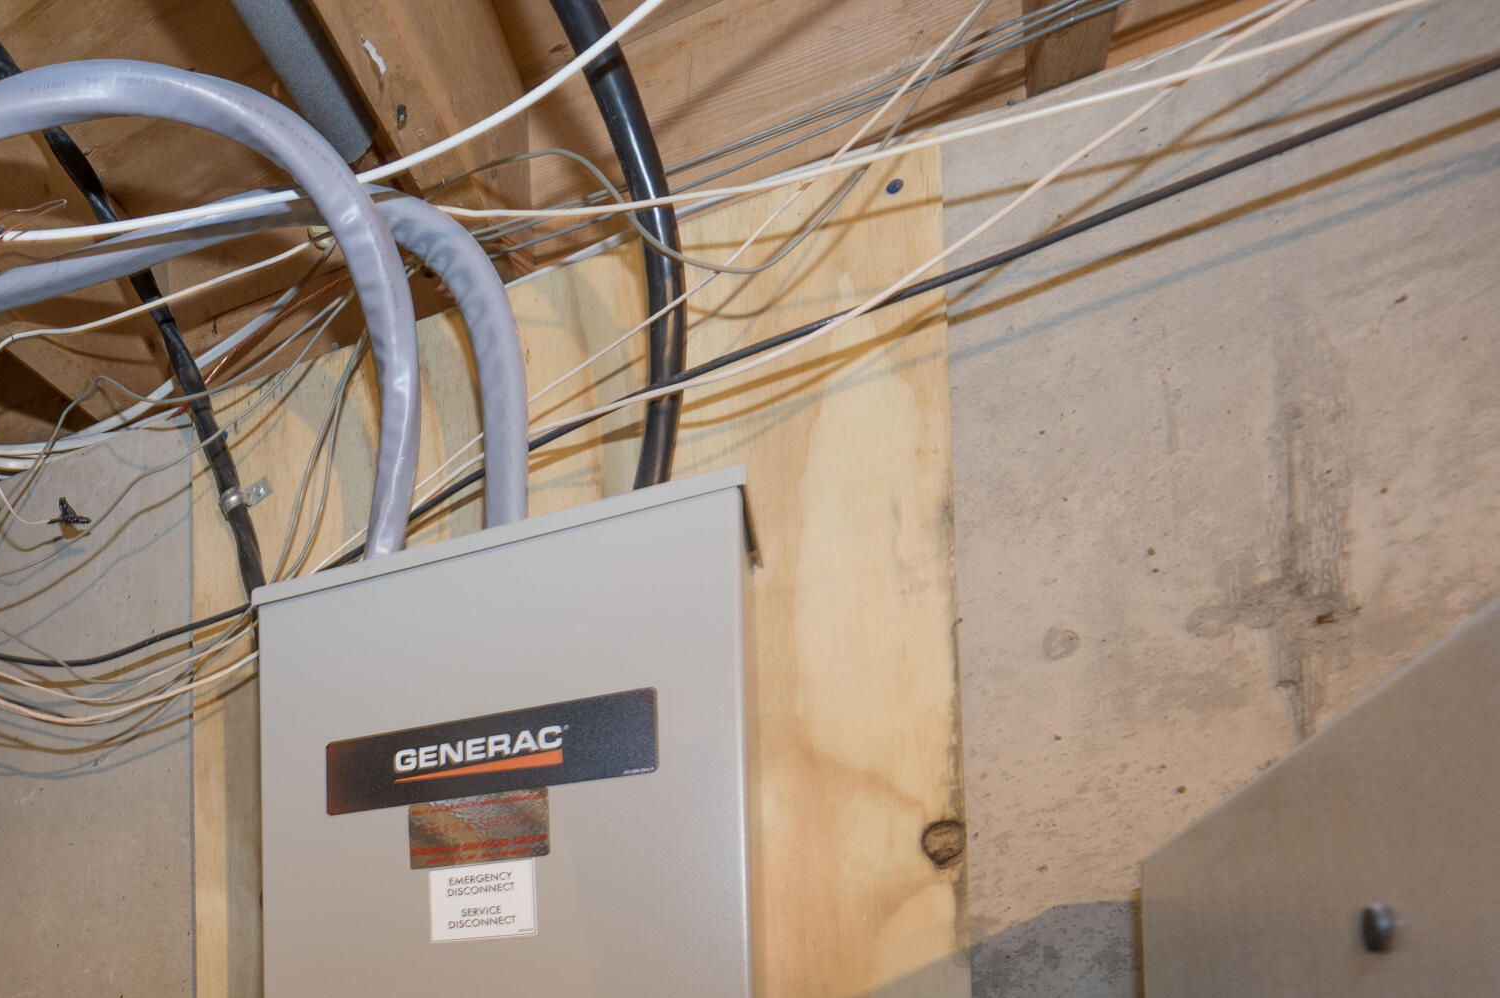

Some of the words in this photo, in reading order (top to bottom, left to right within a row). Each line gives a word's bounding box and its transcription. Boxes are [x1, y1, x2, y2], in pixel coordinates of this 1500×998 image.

[394, 724, 564, 774] GENERAC
[449, 872, 514, 886] EMERGENCY
[447, 881, 516, 898] DISCONNECT
[461, 905, 503, 917] SERVICE
[448, 915, 517, 930] DISCONNECT
